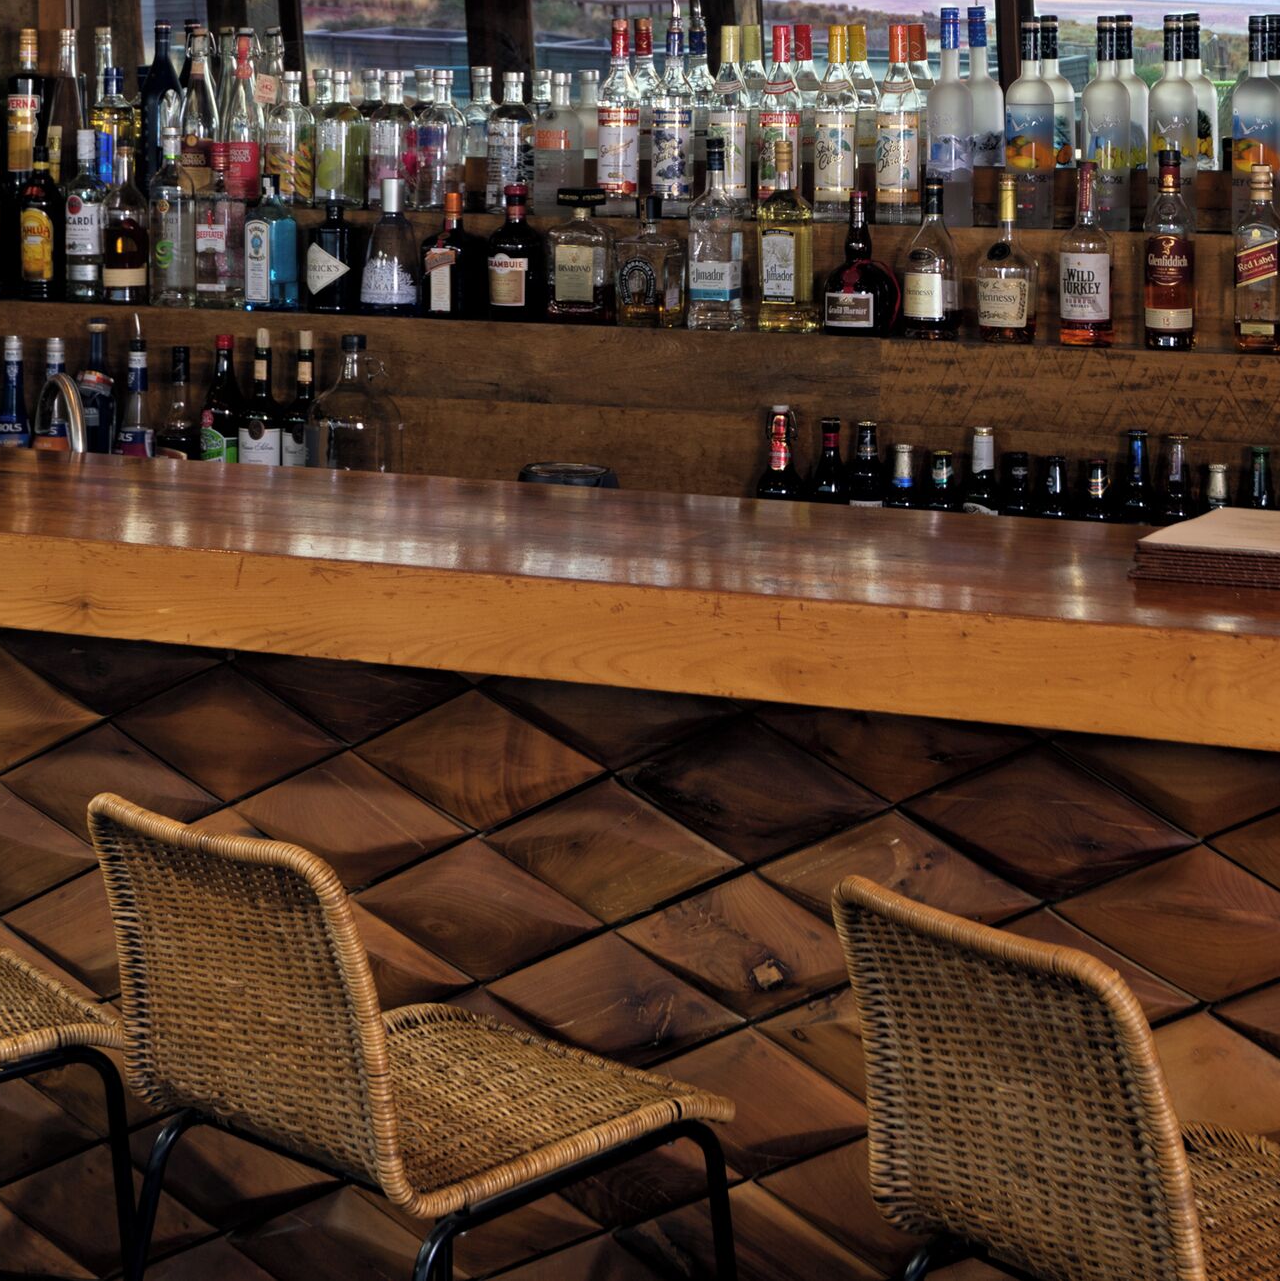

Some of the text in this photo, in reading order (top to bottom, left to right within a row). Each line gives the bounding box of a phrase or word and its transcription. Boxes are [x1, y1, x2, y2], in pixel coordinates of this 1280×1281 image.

[67, 215, 94, 225] CARDÍ
[196, 230, 225, 239] BEEFEATER
[1148, 253, 1188, 267] Glenfiddich
[1238, 260, 1253, 272] Red
[1254, 253, 1276, 267] Label
[309, 264, 340, 272] DRICK'S
[770, 264, 777, 273] el
[693, 268, 725, 283] Jimador
[764, 269, 793, 283] Jimador
[1067, 268, 1095, 282] WILD
[1063, 279, 1101, 295] TURKEY
[978, 291, 1018, 304] Hennessy
[843, 306, 868, 316] Marnier
